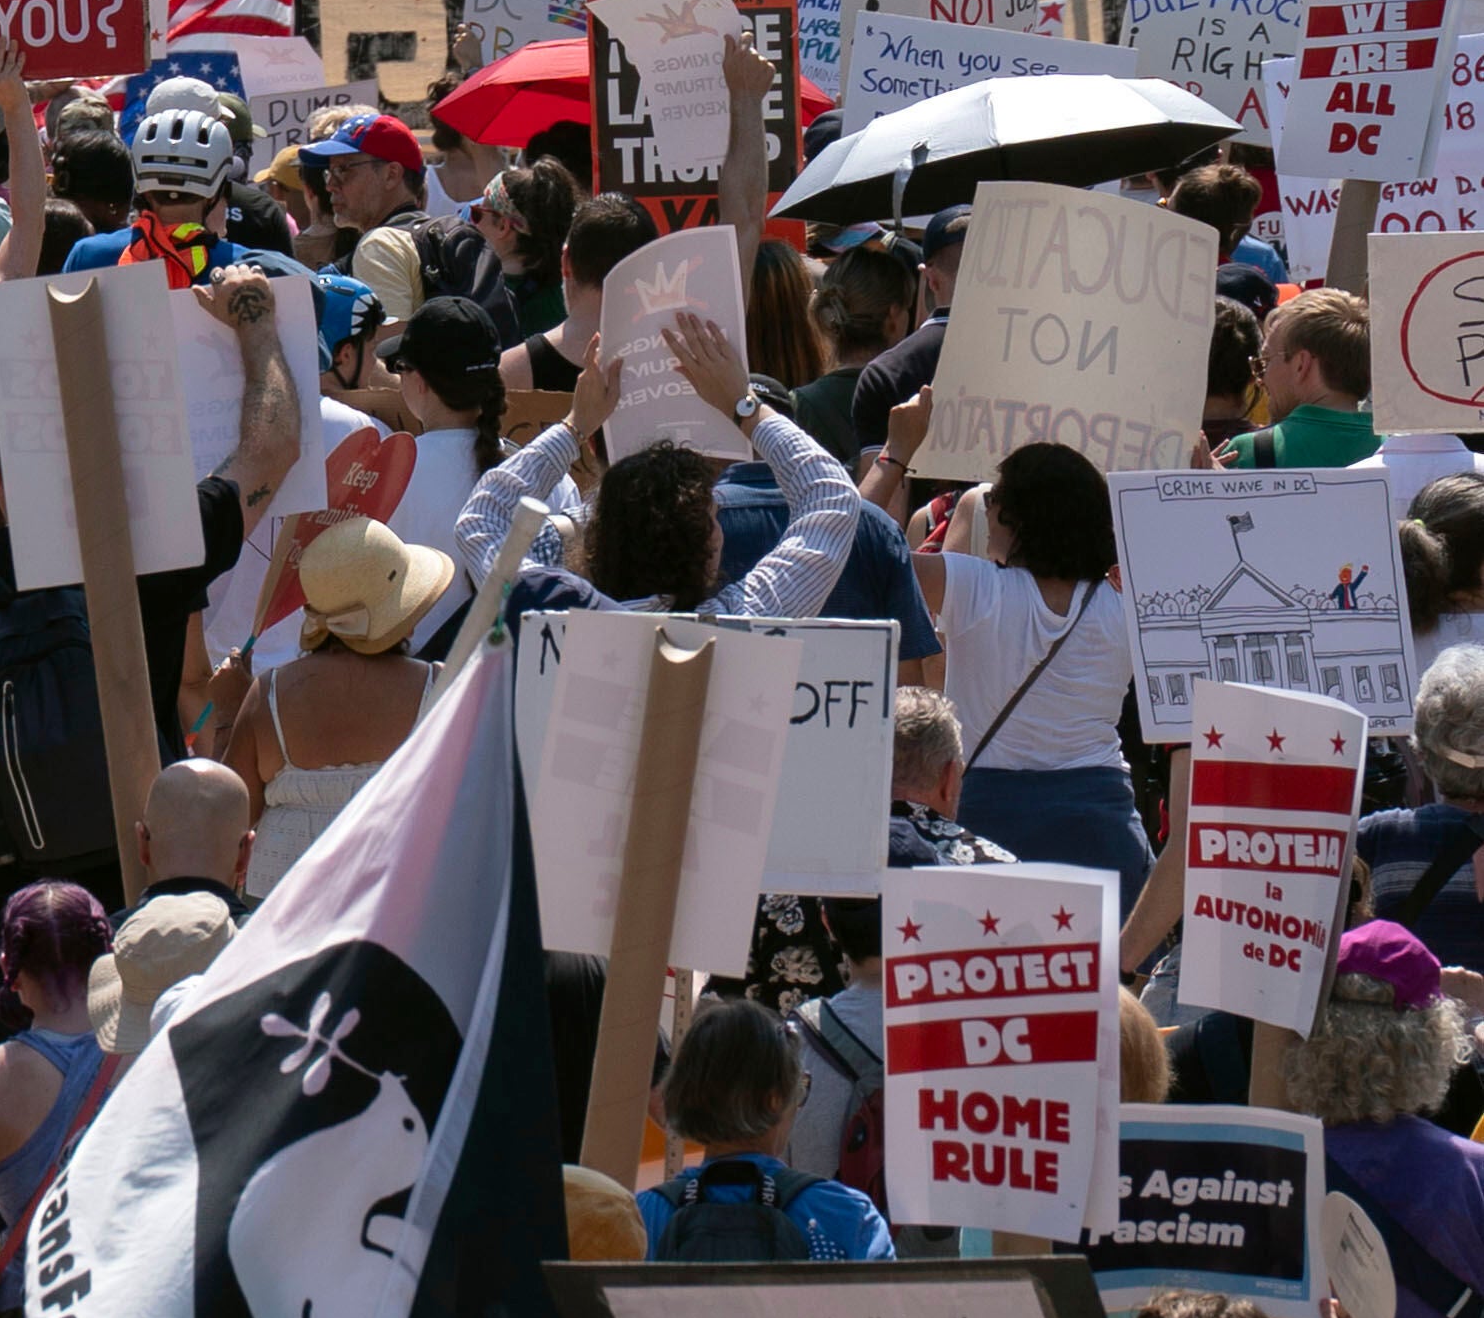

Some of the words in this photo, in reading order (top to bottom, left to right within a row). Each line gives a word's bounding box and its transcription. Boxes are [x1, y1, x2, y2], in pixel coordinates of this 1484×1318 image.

[1200, 17, 1226, 36] IS
[1250, 23, 1270, 44] A
[1342, 3, 1407, 34] WE
[959, 52, 1000, 76] you
[1330, 44, 1408, 76] ARE
[1325, 82, 1396, 116] ALL
[1328, 122, 1382, 155] DC
[1162, 481, 1214, 496] CRIME
[1222, 481, 1262, 493] WAVE
[1274, 479, 1285, 490] IN
[1294, 479, 1311, 491] DC
[1199, 828, 1341, 872] PROTEJA
[1266, 882, 1283, 901] la
[1193, 894, 1326, 948] AUTONOMÍA
[1242, 941, 1265, 961] de
[1268, 948, 1302, 973] DC
[893, 949, 1096, 1000] PROTECT
[961, 1017, 1033, 1065] DC
[918, 1088, 1070, 1144] HOME
[932, 1141, 1059, 1195] RULE
[1140, 1171, 1293, 1210] Against
